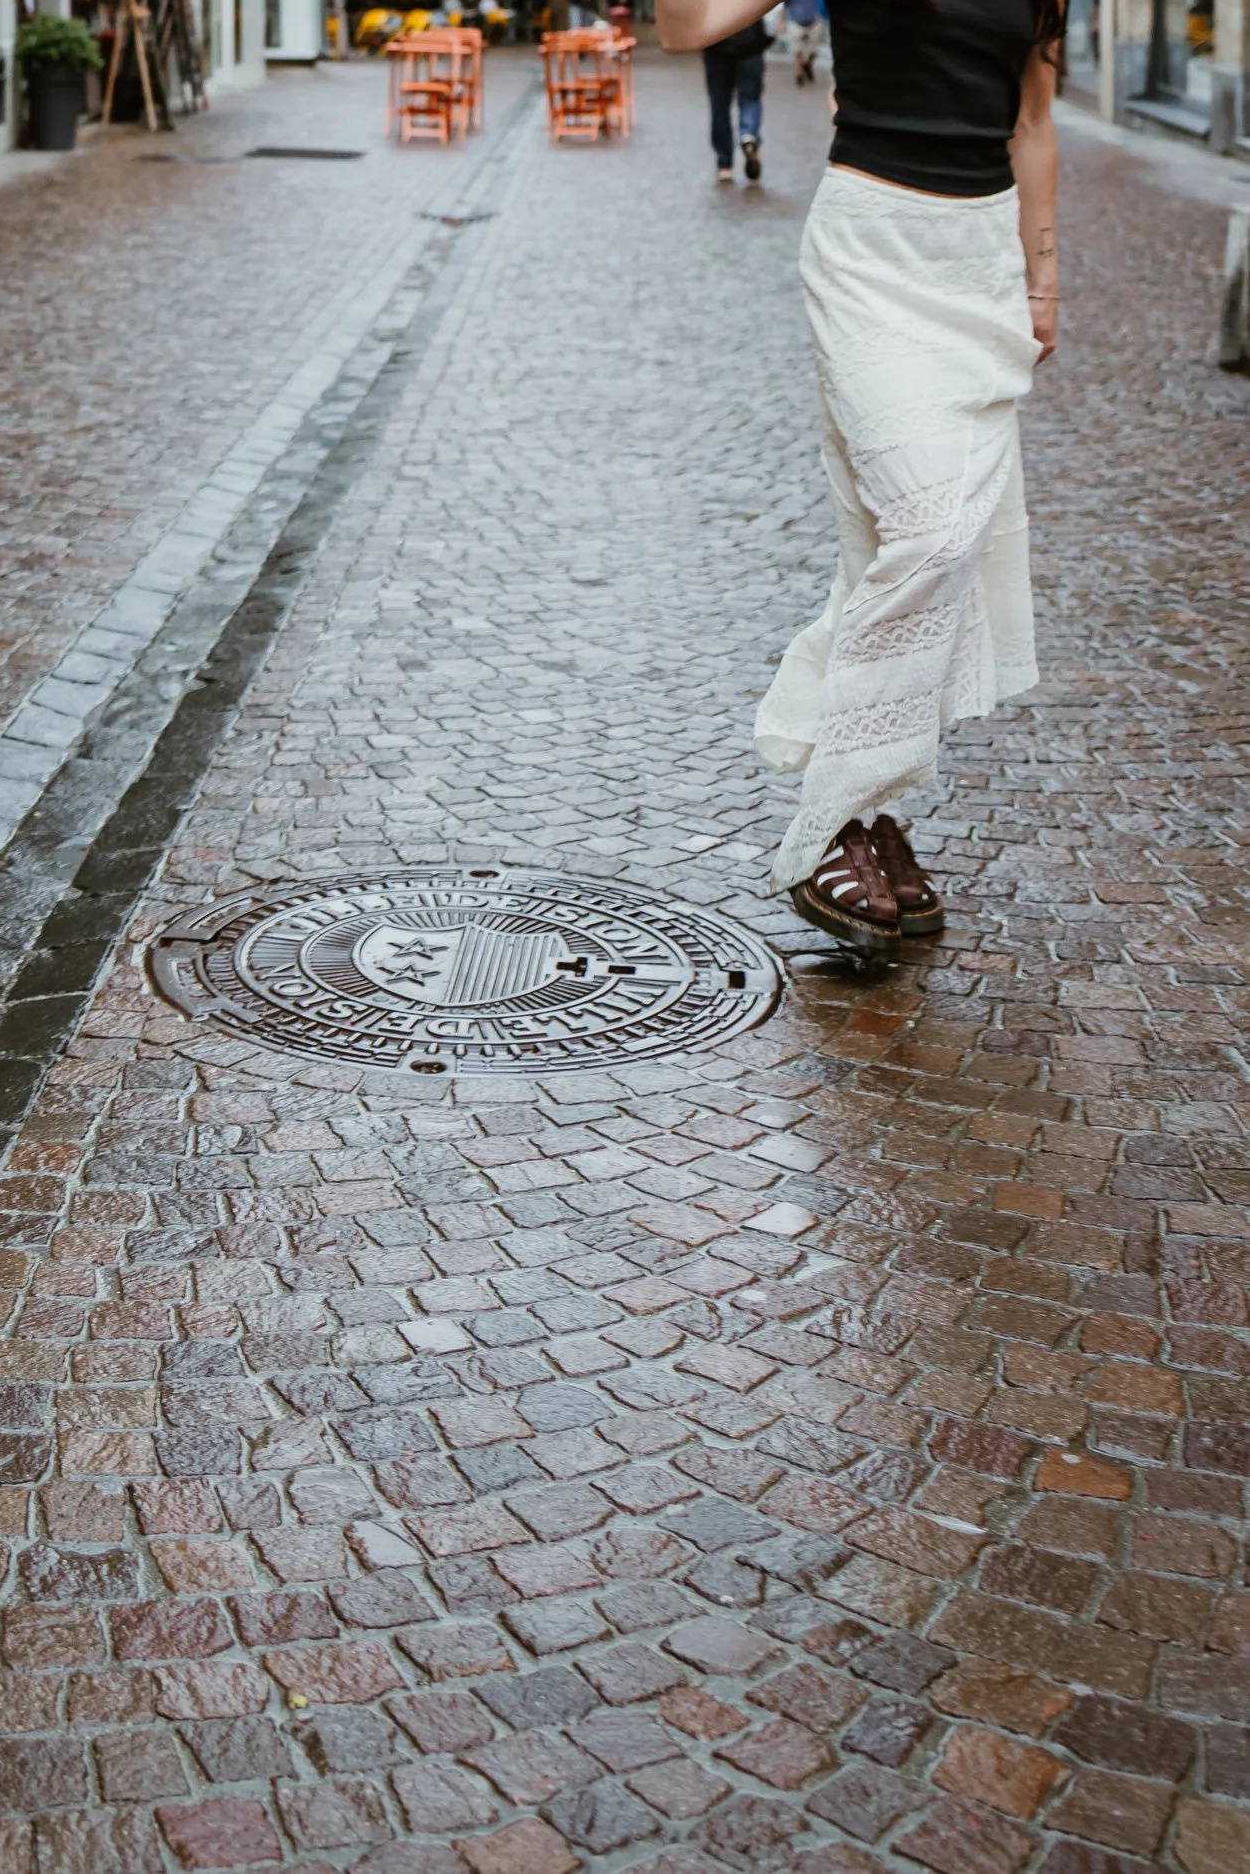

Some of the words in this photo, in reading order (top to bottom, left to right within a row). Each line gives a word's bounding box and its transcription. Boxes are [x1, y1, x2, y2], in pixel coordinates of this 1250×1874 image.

[266, 894, 426, 940] VILLE
[445, 894, 533, 912] DE
[549, 904, 669, 960] SION
[259, 963, 366, 1020] SION
[504, 985, 666, 1037] VILLE
[382, 1014, 475, 1037] DE
